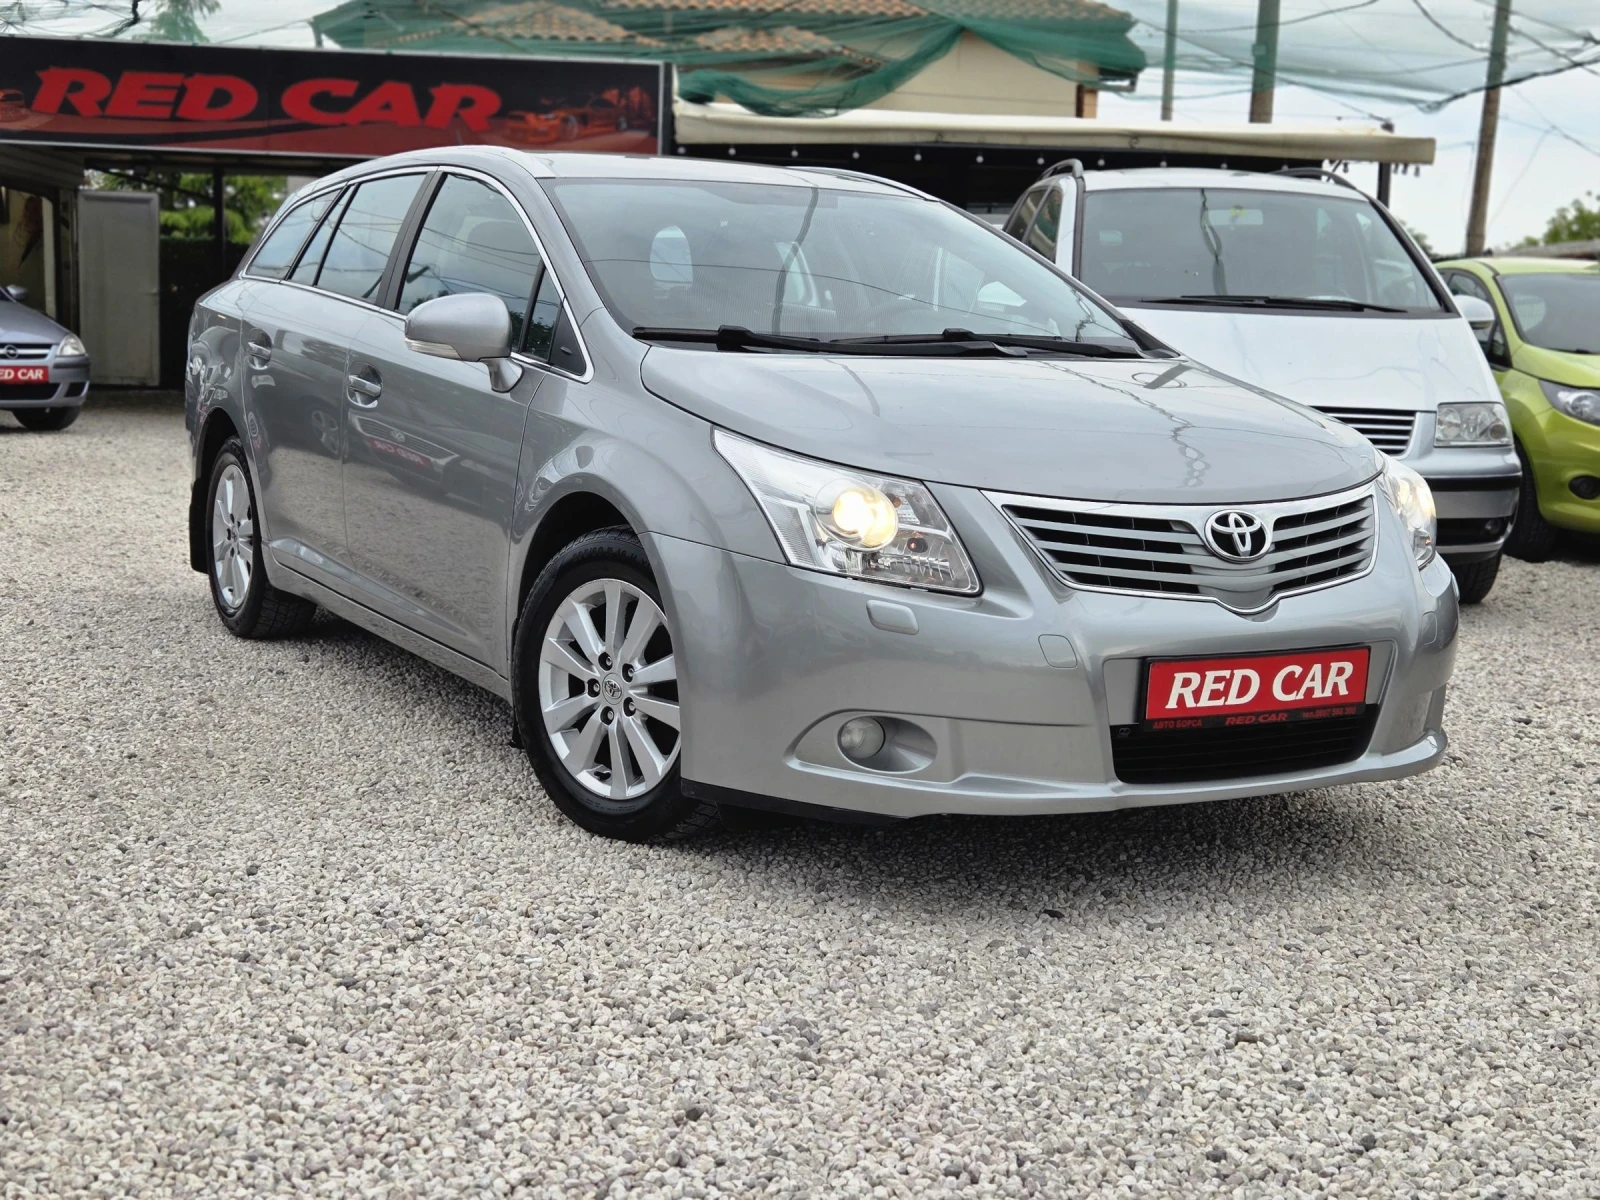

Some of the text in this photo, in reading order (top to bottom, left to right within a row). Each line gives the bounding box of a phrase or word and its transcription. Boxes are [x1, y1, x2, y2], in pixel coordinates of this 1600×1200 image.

[31, 66, 502, 133] RED CAR
[0, 368, 44, 381] ED CAR
[1165, 661, 1353, 709] RED CAR
[1225, 712, 1288, 726] RED CAR
